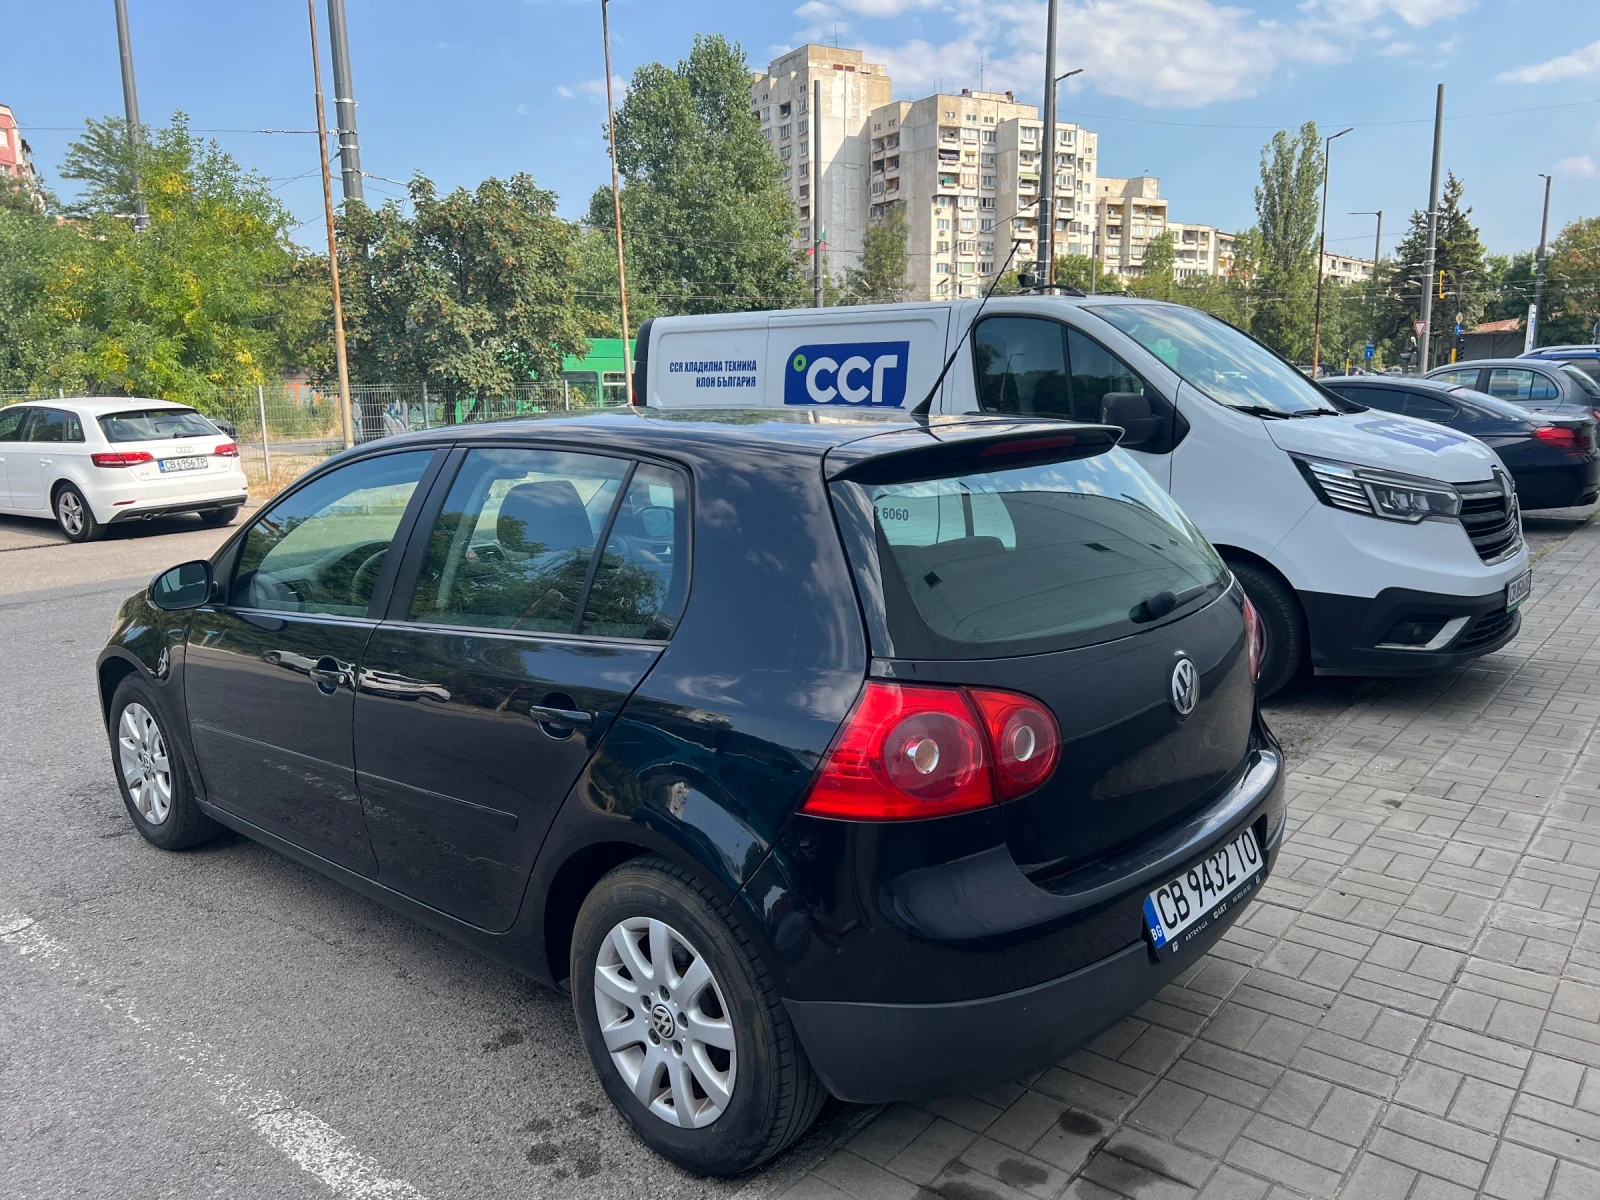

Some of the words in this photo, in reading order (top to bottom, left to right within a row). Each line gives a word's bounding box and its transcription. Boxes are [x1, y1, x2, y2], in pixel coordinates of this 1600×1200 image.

[684, 360, 723, 374] ХЛАДИЛНА
[724, 360, 757, 372] ТЕХНИКА
[696, 376, 716, 388] КЛОН
[717, 376, 756, 388] БЪЛГАРИЯ
[177, 458, 195, 469] 6956
[882, 507, 909, 521] 6060
[1156, 879, 1191, 930] CB
[1187, 848, 1237, 909] 9432
[1230, 829, 1257, 873] TO
[1150, 925, 1163, 941] BG
